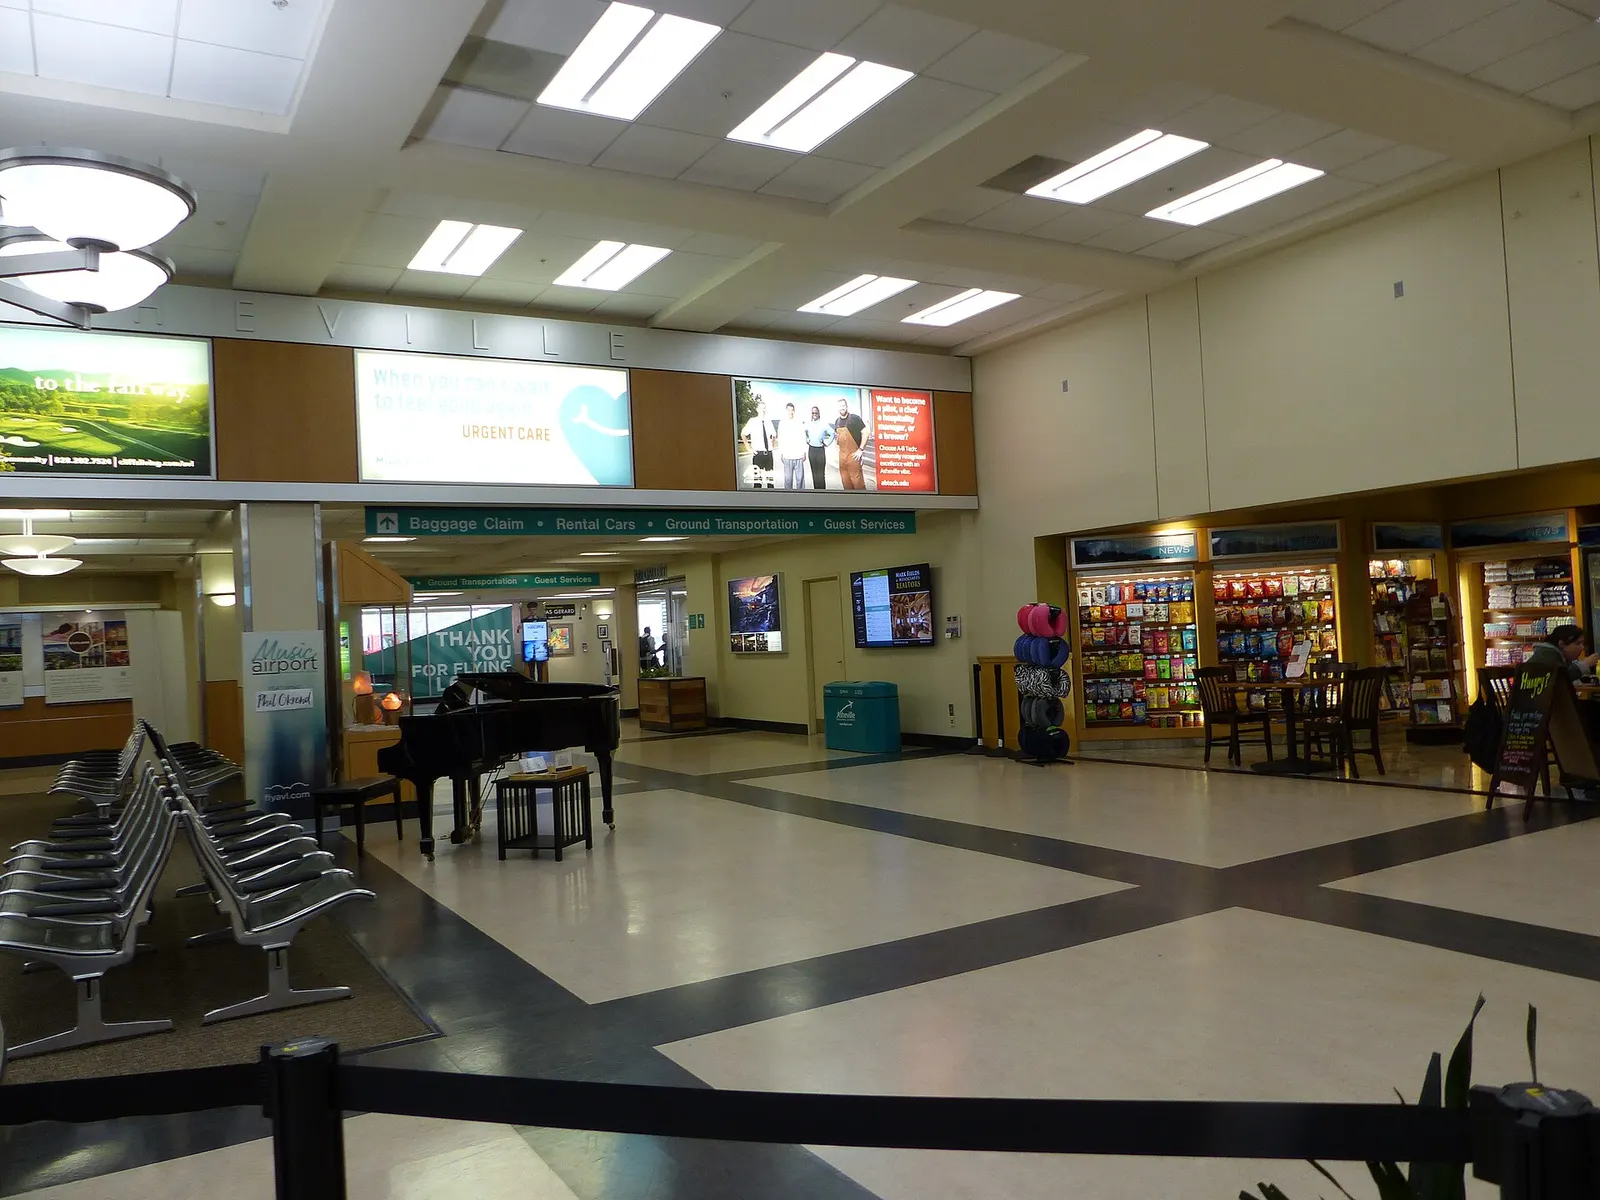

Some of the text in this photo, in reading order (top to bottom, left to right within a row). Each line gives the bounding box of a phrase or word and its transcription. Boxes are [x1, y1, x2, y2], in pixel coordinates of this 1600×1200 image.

[34, 376, 58, 391] to
[65, 372, 100, 393] the
[462, 424, 551, 441] URGENT CARE
[410, 516, 905, 532] Baggage Claim Rental Cars Ground Transportation Guest Services
[1159, 545, 1190, 555] NEWS
[428, 575, 592, 587] Ground Transportation Guest Services
[436, 629, 510, 647] THANK
[252, 638, 317, 662] Music
[467, 644, 512, 661] YOU
[252, 656, 317, 675] airport
[412, 660, 512, 677] FOR FLYING
[1520, 671, 1551, 699] Hungry?
[257, 694, 276, 710] Phil
